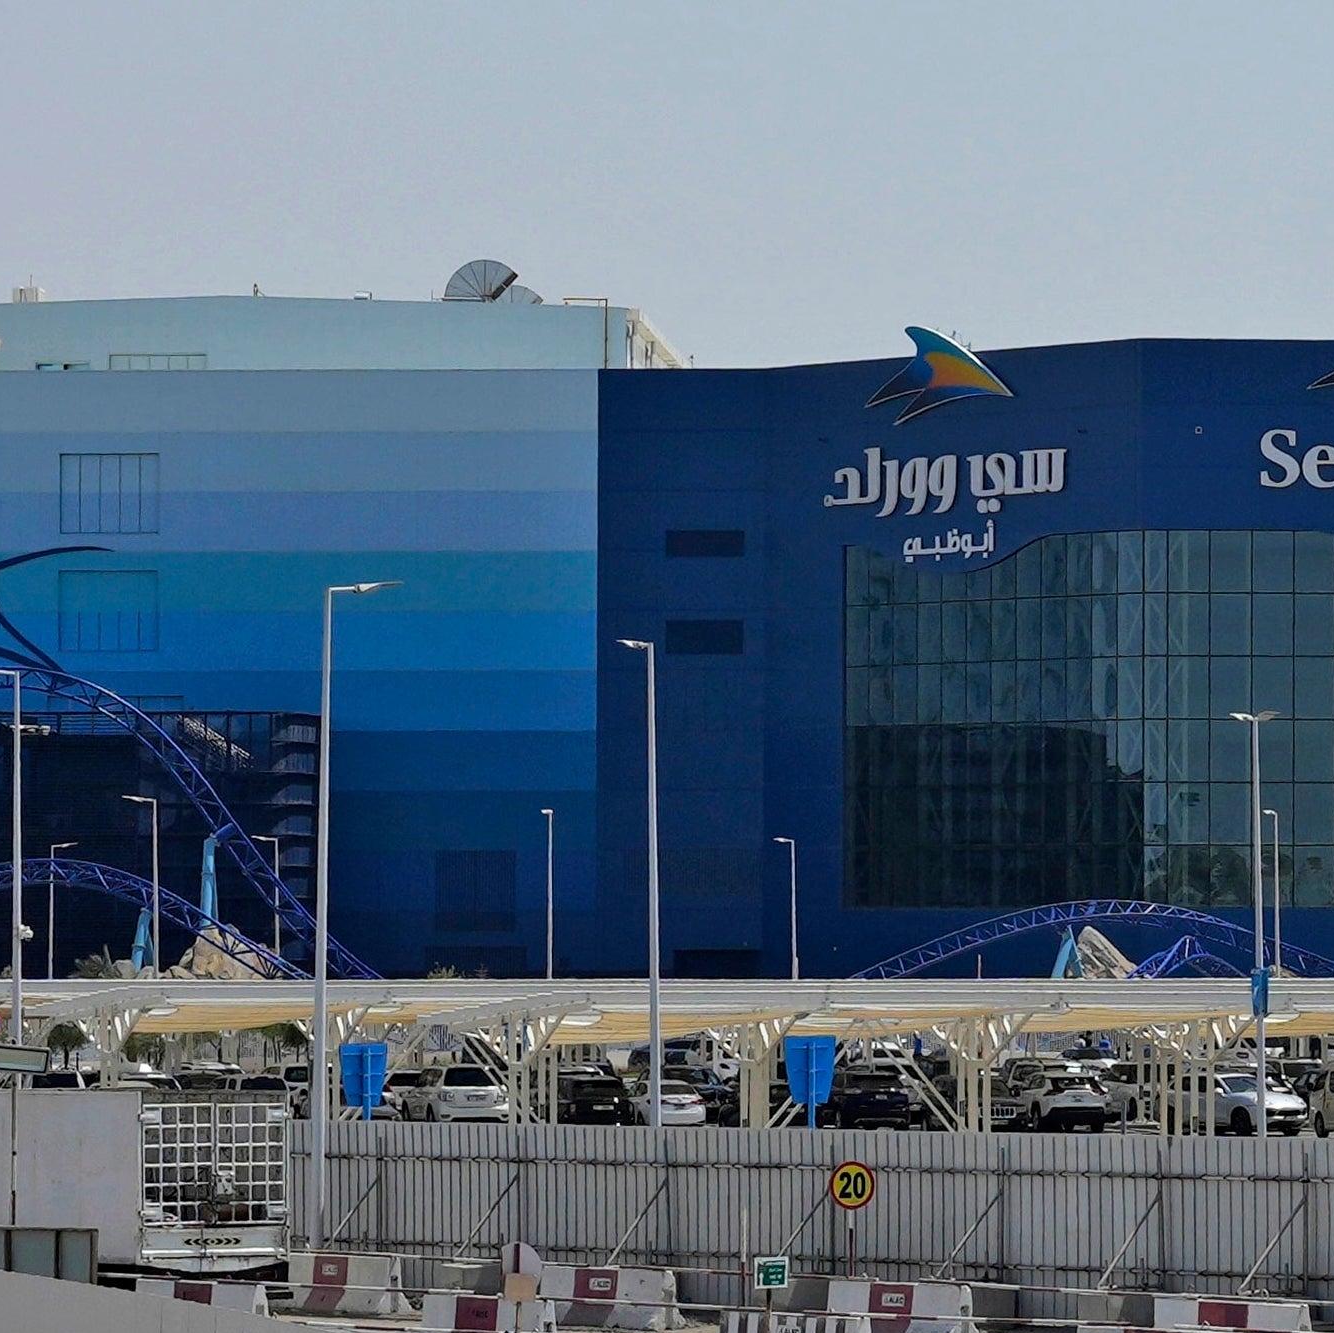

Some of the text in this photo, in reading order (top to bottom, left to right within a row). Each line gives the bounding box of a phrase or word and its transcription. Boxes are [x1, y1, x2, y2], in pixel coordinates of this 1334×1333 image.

[824, 447, 1067, 518] سي وورلد
[903, 519, 995, 563] أبوظبي
[838, 1171, 866, 1199] 20
